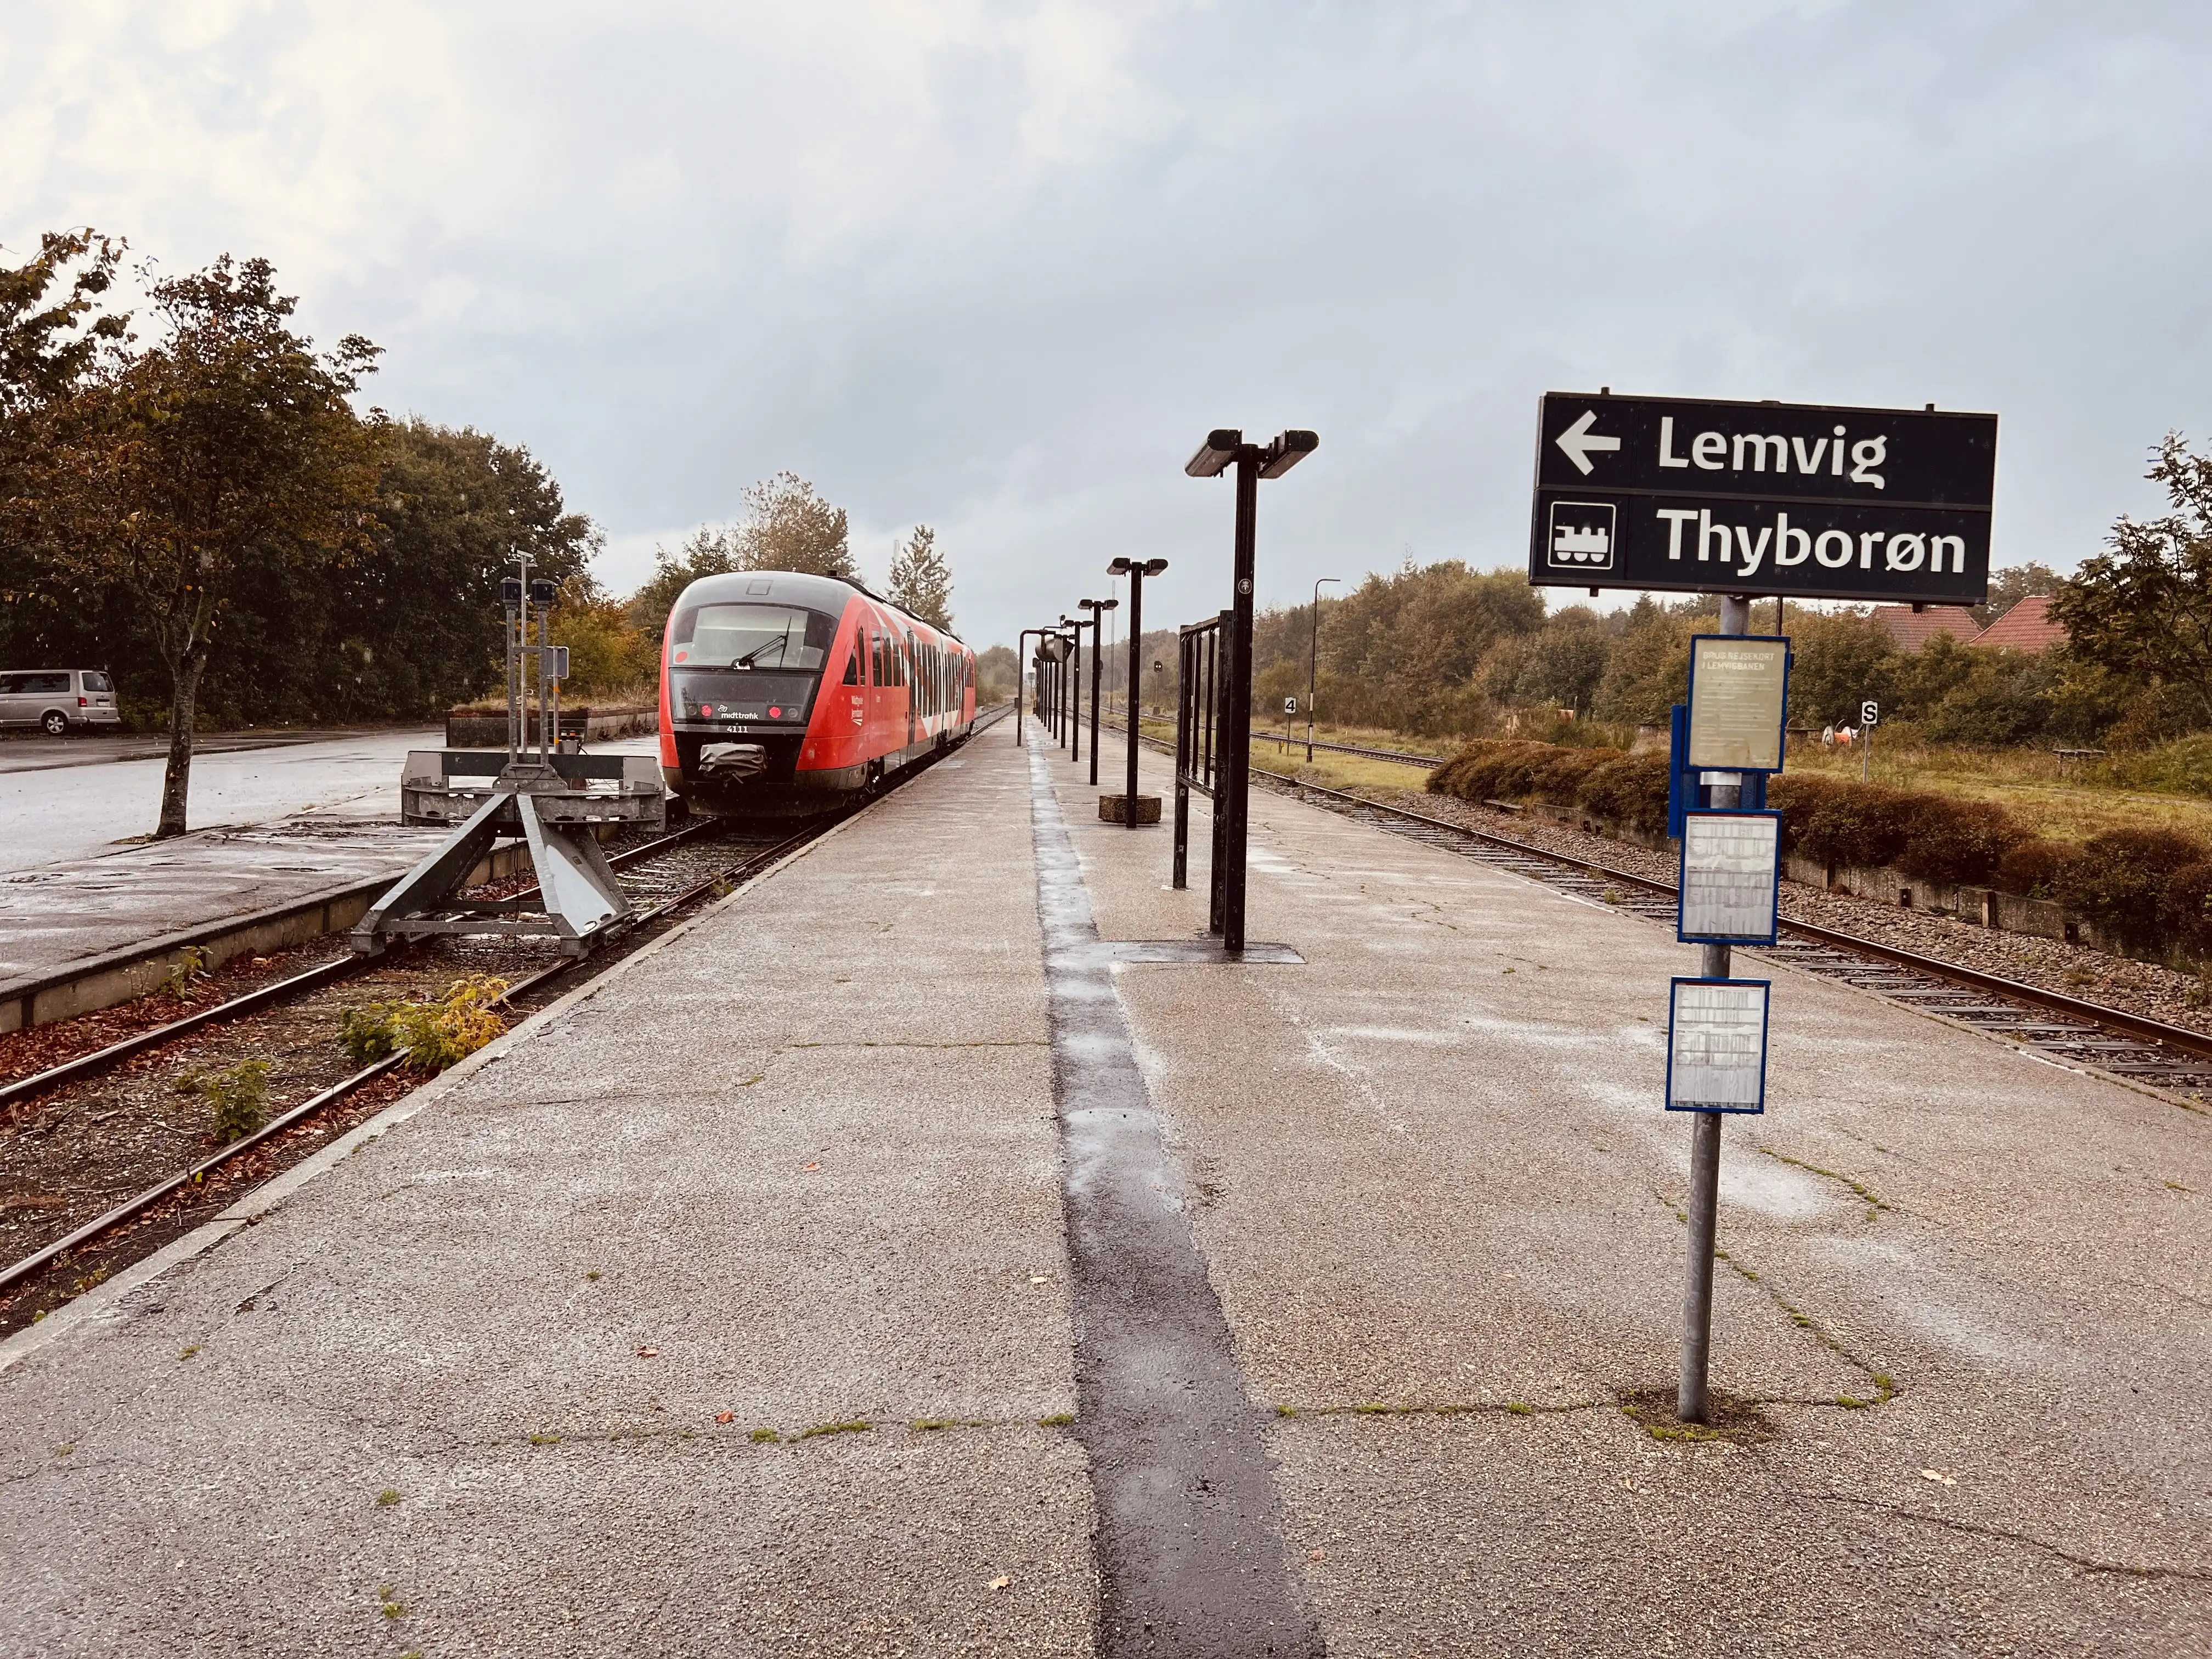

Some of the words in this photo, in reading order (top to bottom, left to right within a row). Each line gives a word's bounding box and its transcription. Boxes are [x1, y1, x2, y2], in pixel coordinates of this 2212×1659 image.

[1659, 416, 1888, 490] Lemvig
[1656, 509, 1966, 577] Thyborøn
[1285, 699, 1295, 712] 4
[1863, 704, 1876, 722] S
[721, 712, 759, 720] midttrafik
[726, 725, 748, 733] 4111
